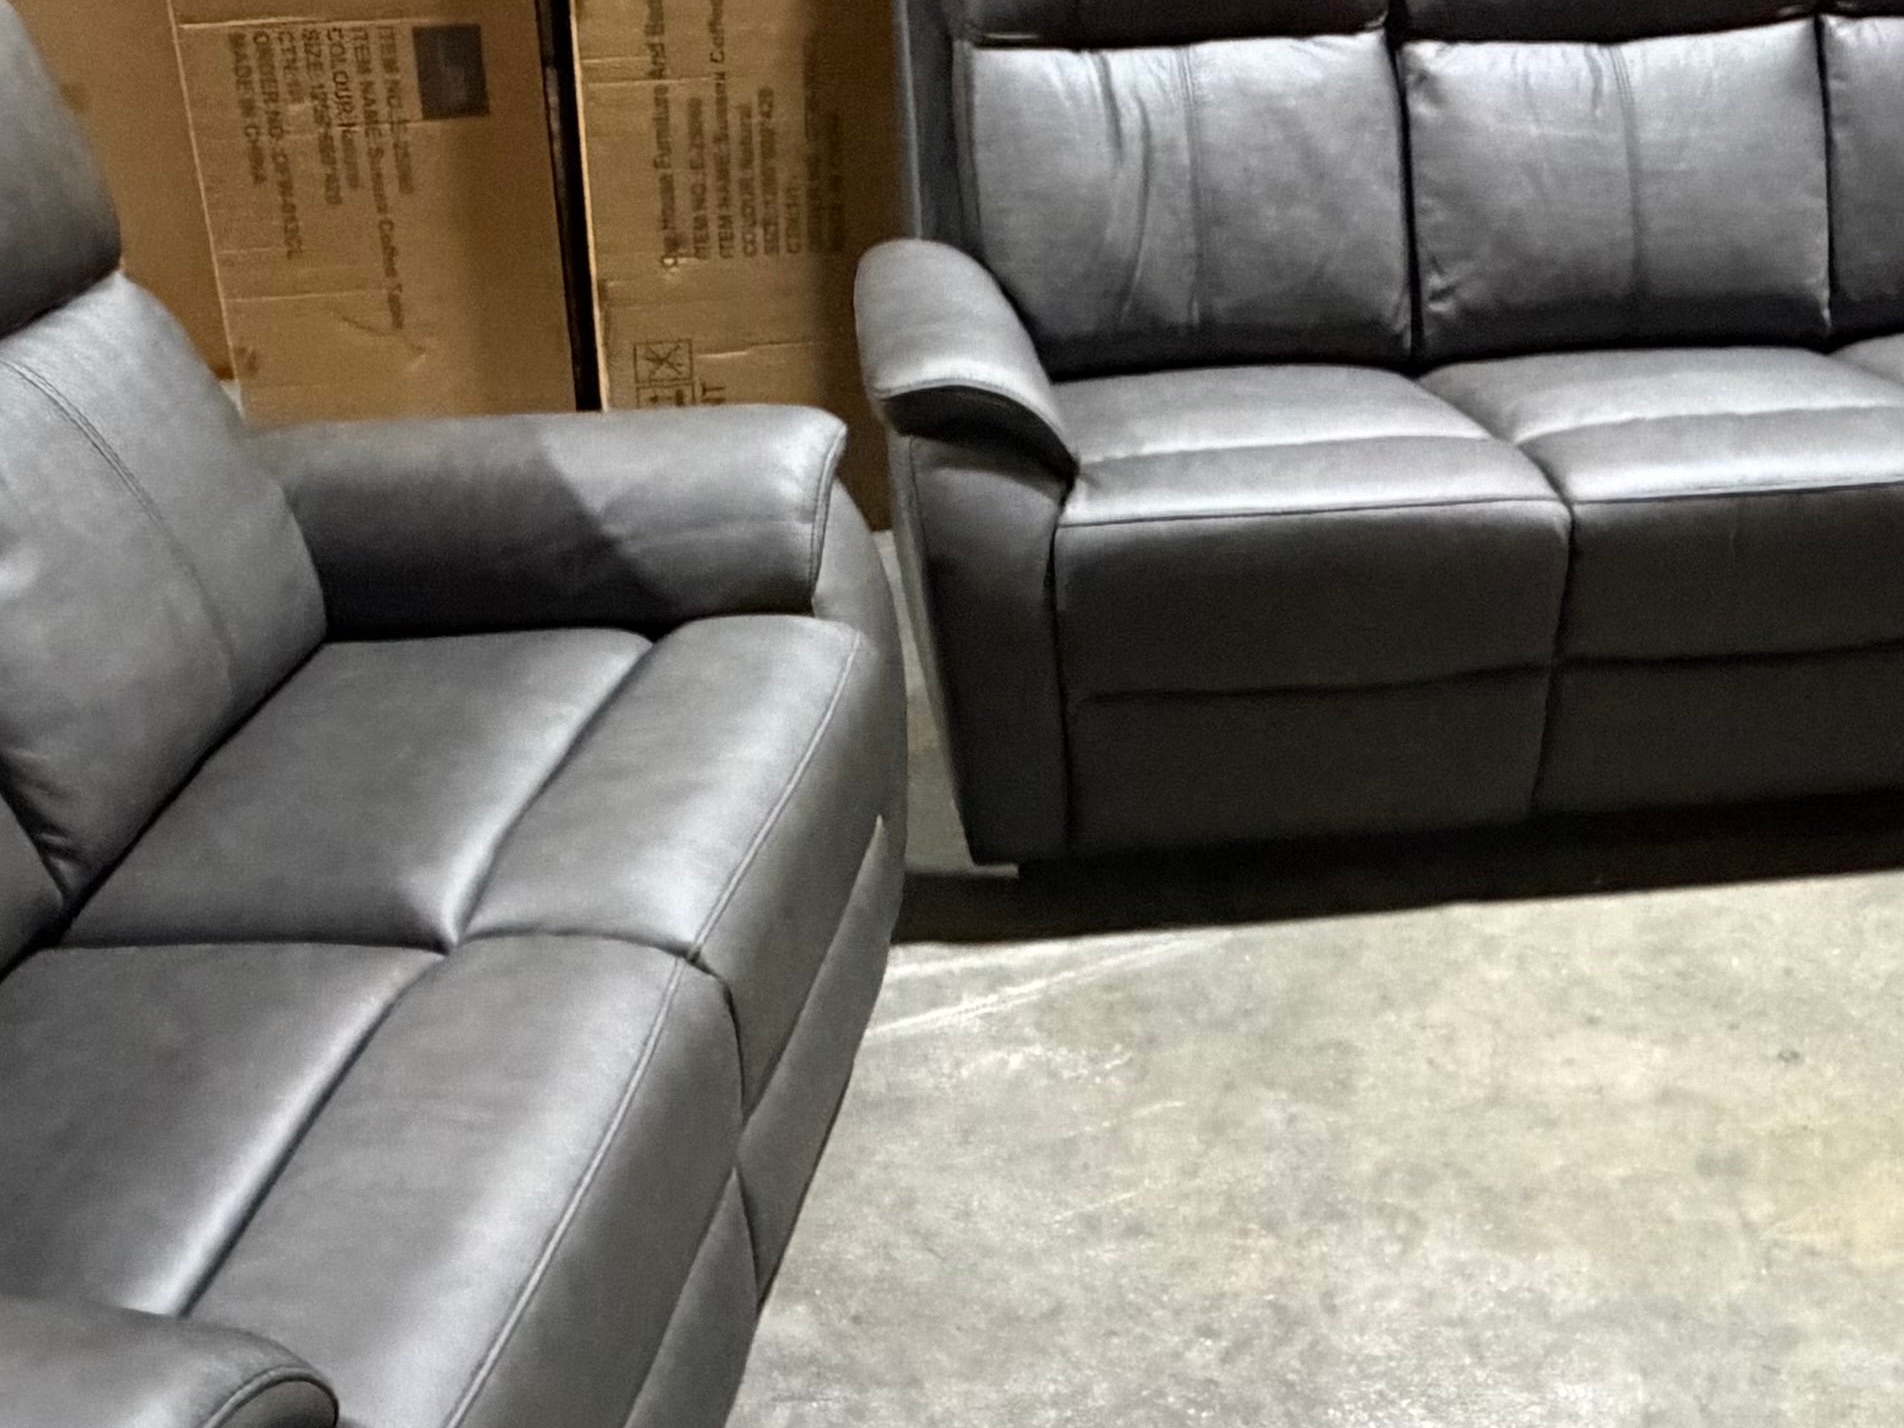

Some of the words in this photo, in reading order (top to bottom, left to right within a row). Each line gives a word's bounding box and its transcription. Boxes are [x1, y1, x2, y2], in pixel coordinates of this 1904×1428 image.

[227, 31, 254, 91] MADE
[351, 28, 376, 75] ITEM
[645, 42, 667, 80] And
[238, 98, 257, 118] IN
[692, 215, 712, 260] ITEM
[717, 215, 735, 260] ITEM
